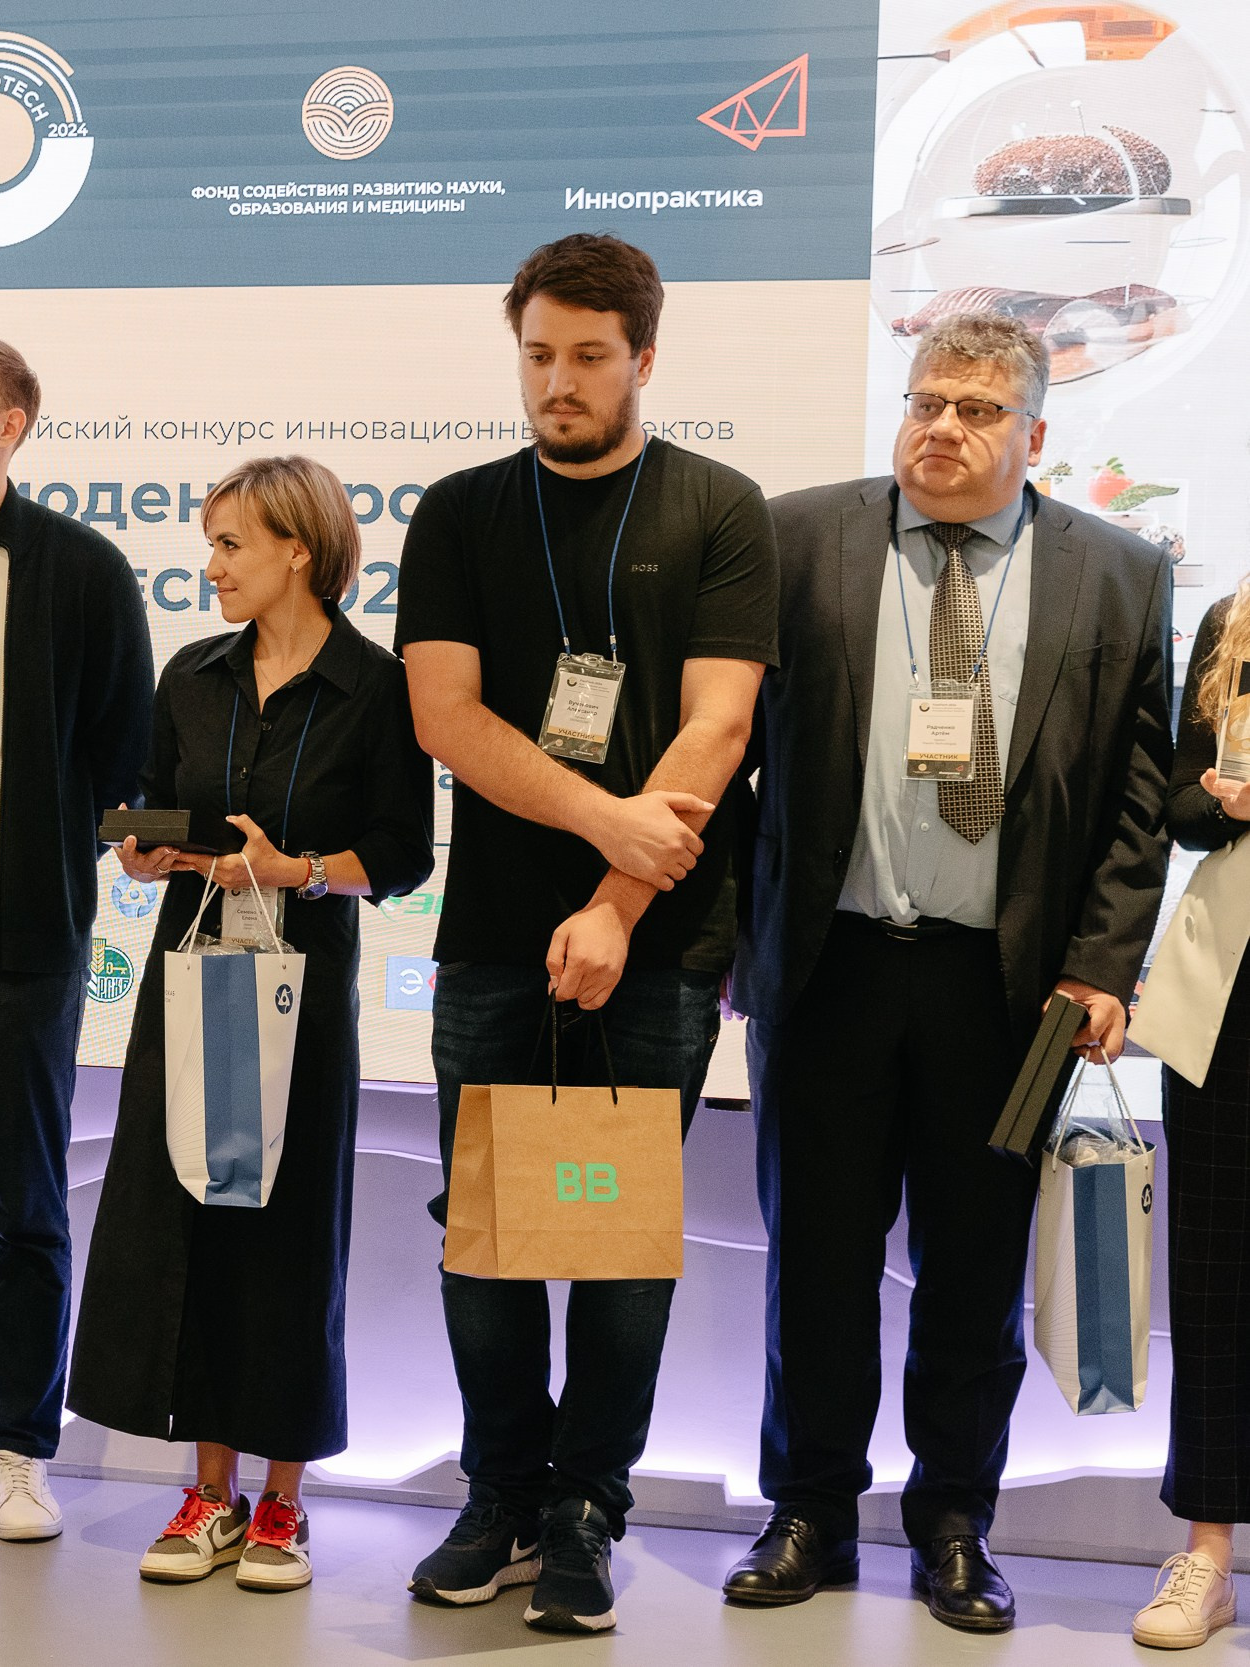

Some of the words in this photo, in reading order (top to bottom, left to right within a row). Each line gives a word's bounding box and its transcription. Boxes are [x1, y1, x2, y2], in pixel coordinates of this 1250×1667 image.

[48, 123, 89, 137] 2024
[191, 185, 240, 200] ФОНД
[243, 182, 349, 200] СОДЕЙСТВИЯ
[353, 182, 443, 196] РАЗВИТИЮ
[446, 181, 506, 196] НАУКИ,
[229, 201, 348, 216] ОБРАЗОВАНИЯ
[352, 200, 364, 213] И
[367, 199, 466, 215] МЕДИЦИНЫ
[565, 186, 764, 214] Иннопрактика
[144, 421, 275, 445] конкурс
[631, 564, 659, 572] BOSS
[558, 728, 595, 740] УЧАСТНИК
